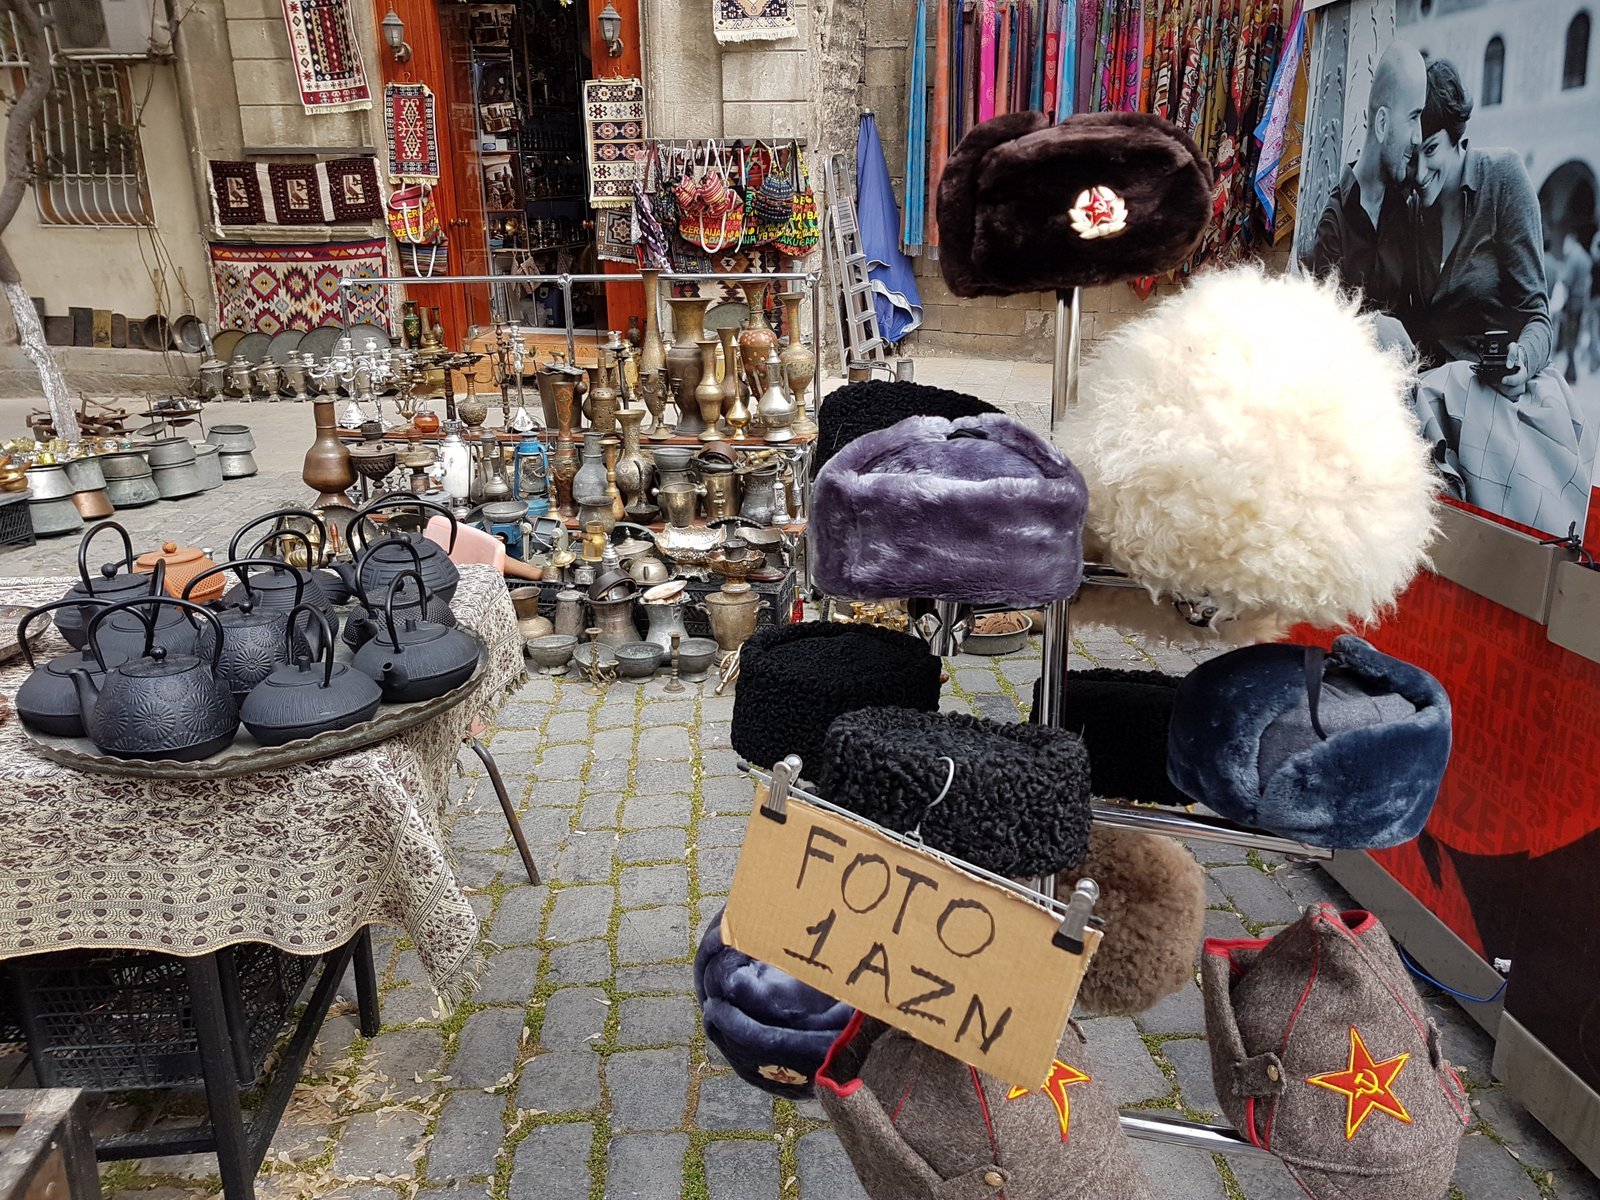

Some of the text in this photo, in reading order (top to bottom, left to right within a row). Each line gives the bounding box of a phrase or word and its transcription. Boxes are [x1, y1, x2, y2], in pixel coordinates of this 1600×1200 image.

[1445, 630, 1558, 732] PARIS
[796, 825, 996, 958] FOTO
[783, 909, 1013, 1054] 1 AZN
